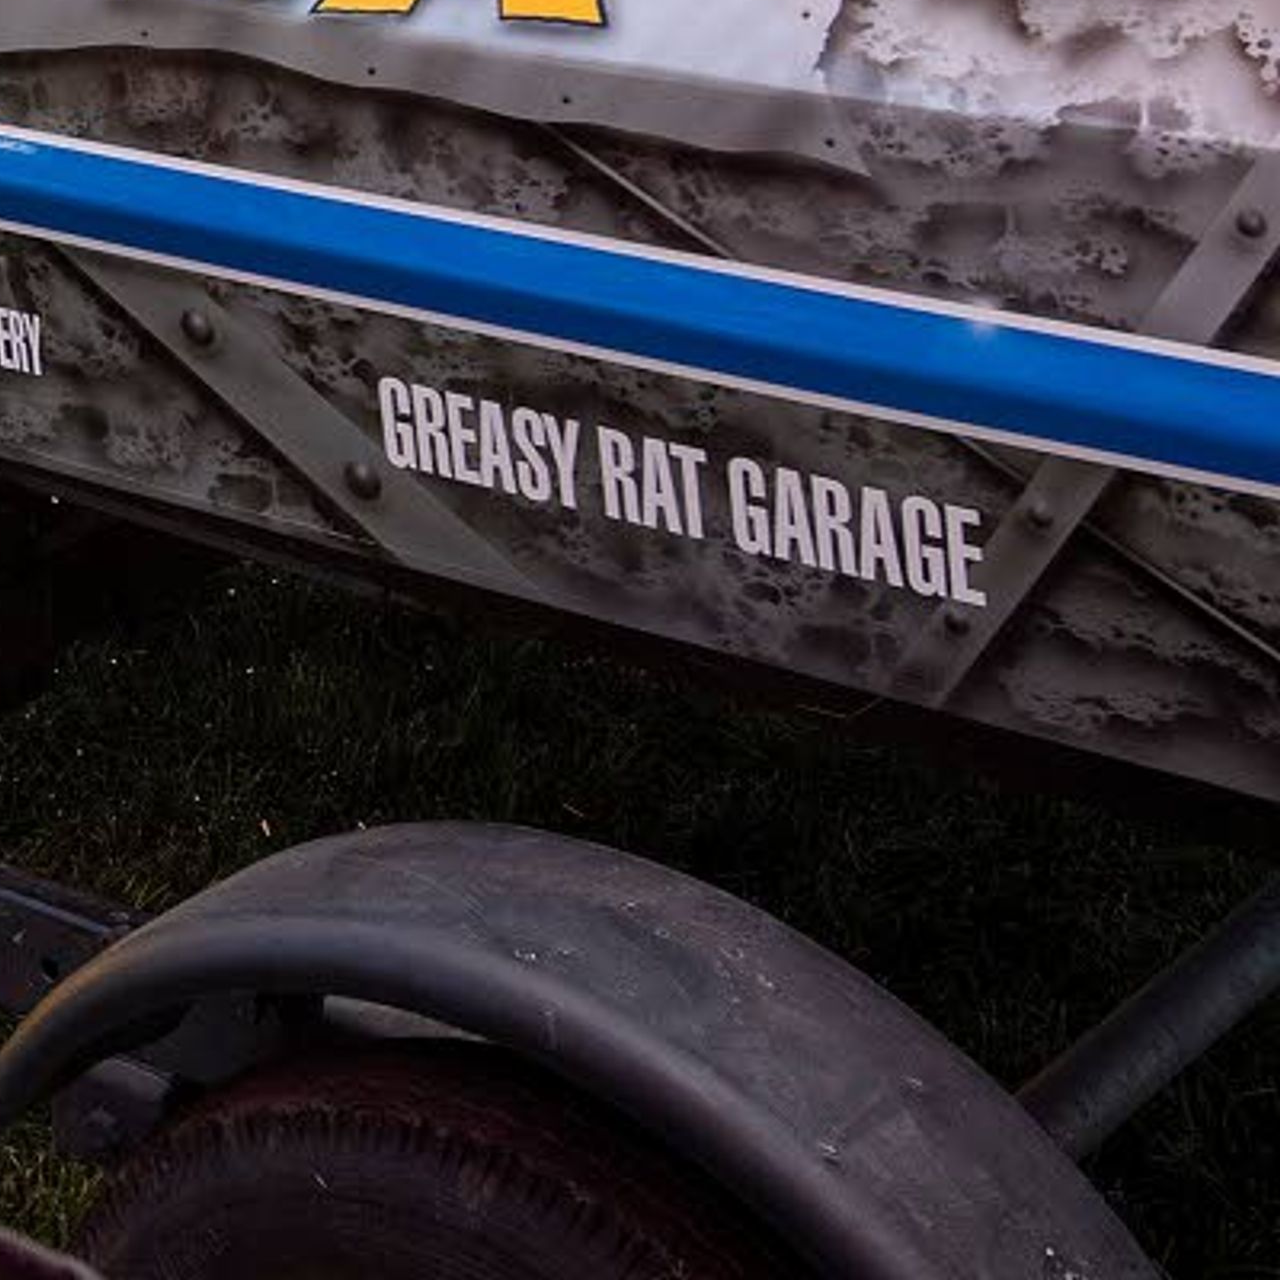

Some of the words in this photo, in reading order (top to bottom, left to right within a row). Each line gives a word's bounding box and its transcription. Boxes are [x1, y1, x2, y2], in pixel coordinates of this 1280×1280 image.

[376, 376, 581, 510] GREASY
[596, 425, 707, 540] RAT
[729, 456, 988, 607] GARAGE
